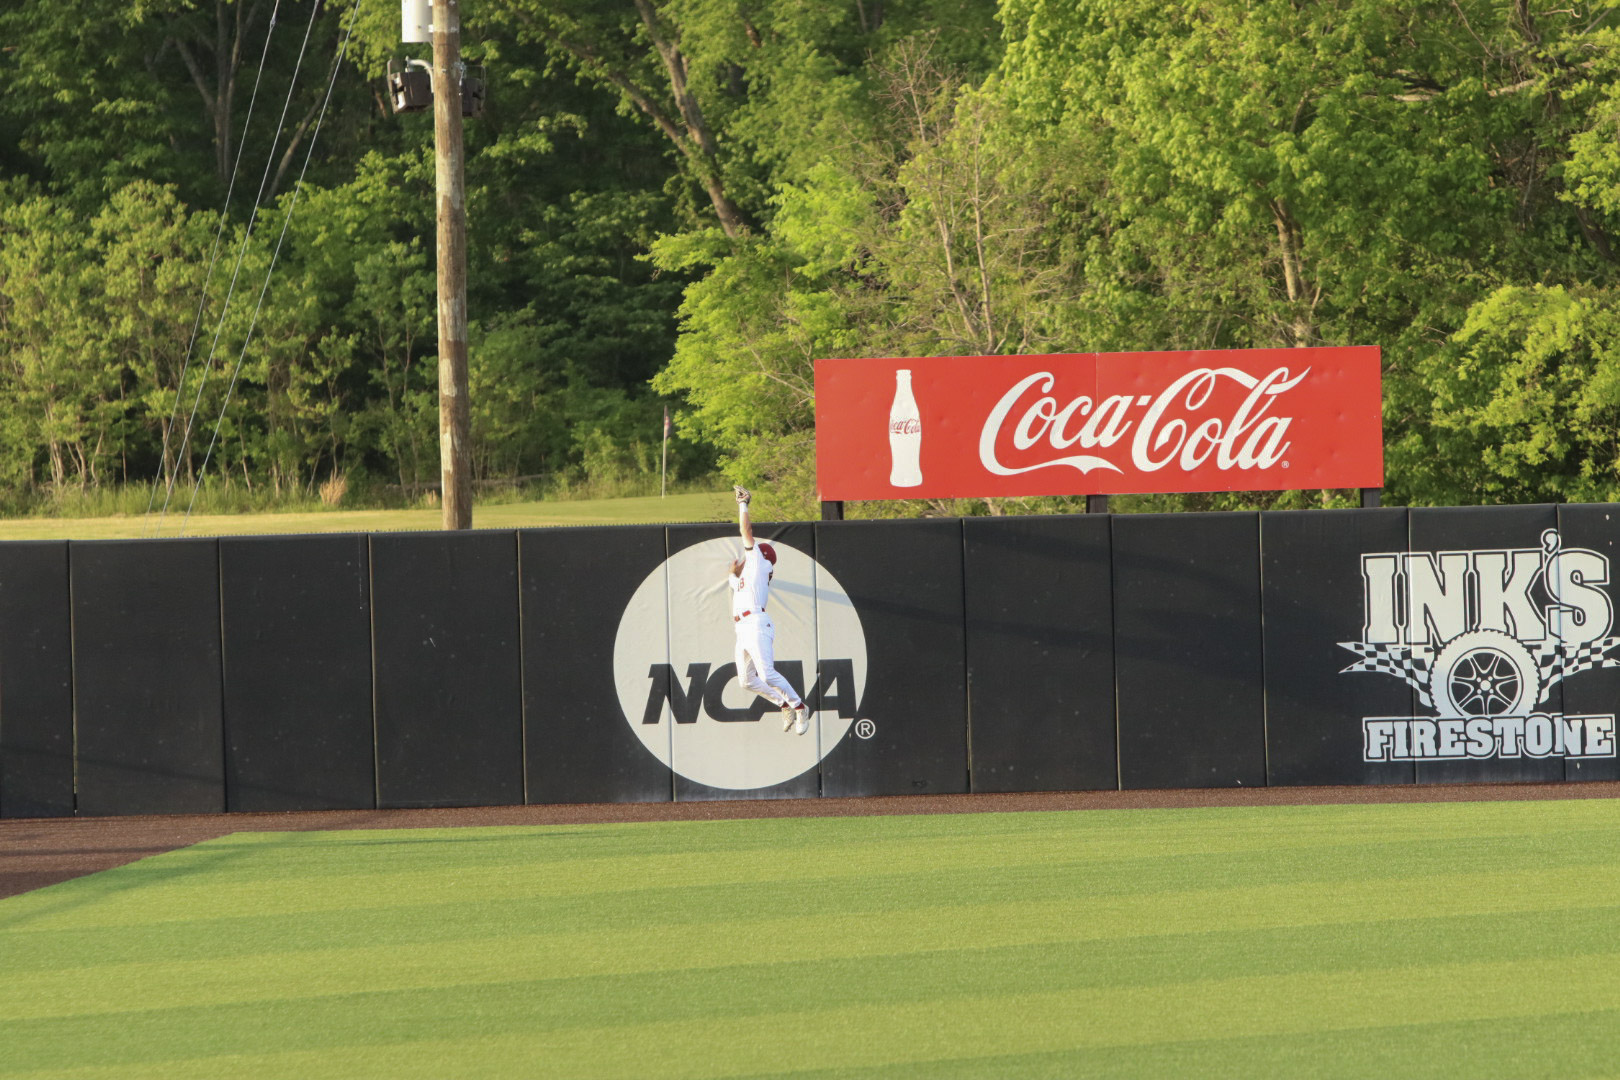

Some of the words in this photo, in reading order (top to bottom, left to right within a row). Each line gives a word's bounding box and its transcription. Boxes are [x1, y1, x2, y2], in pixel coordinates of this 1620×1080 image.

[889, 419, 921, 434] oca-Cola
[979, 366, 1311, 476] Coca-Cola
[1361, 528, 1614, 647] INK'S
[1363, 713, 1616, 761] FIRESTONE
